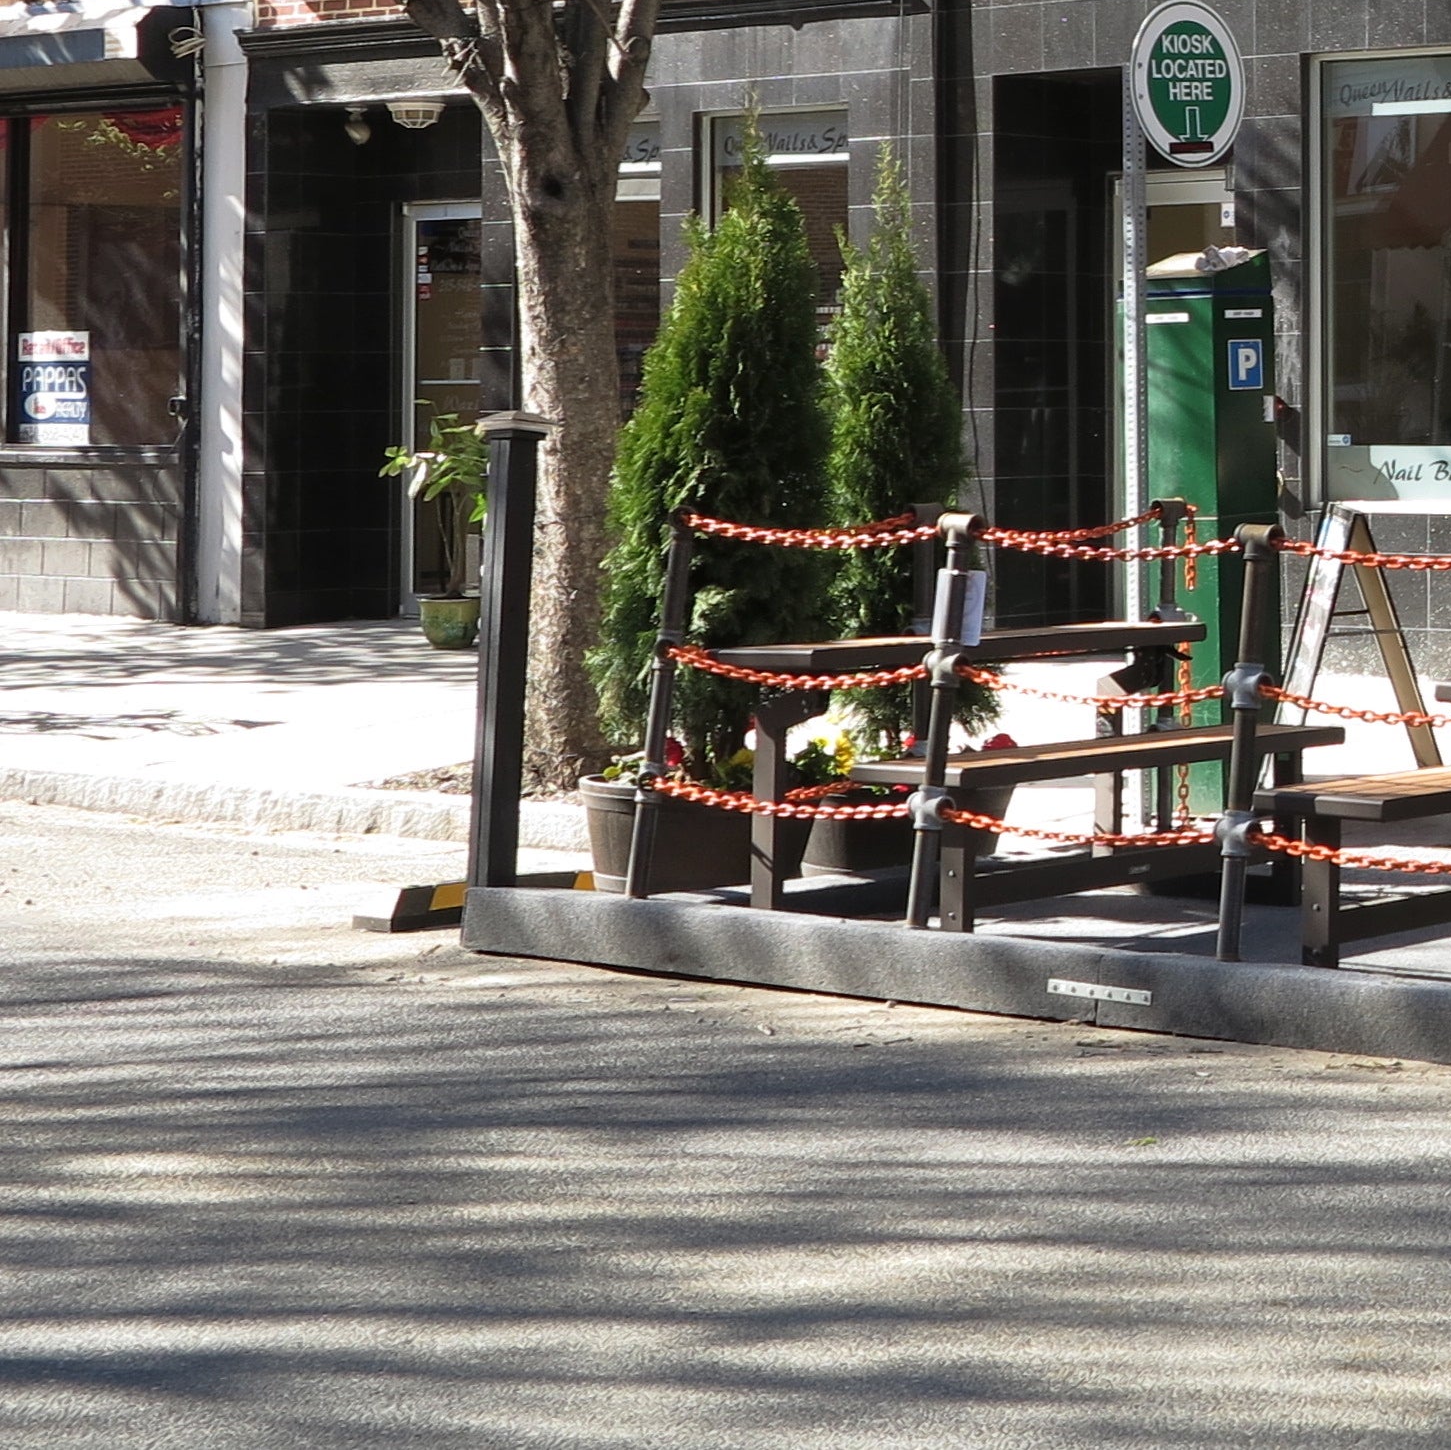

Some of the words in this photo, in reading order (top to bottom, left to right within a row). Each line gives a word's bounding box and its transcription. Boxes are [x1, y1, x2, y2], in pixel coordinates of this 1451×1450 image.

[1161, 34, 1215, 53] KIOSK
[1151, 59, 1227, 79] LOCATED
[1168, 81, 1214, 101] HERE
[1339, 81, 1389, 106] Queen
[818, 127, 849, 154] Sp
[1238, 347, 1257, 381] P
[22, 365, 87, 392] PAPPAS
[1373, 458, 1424, 485] Nail
